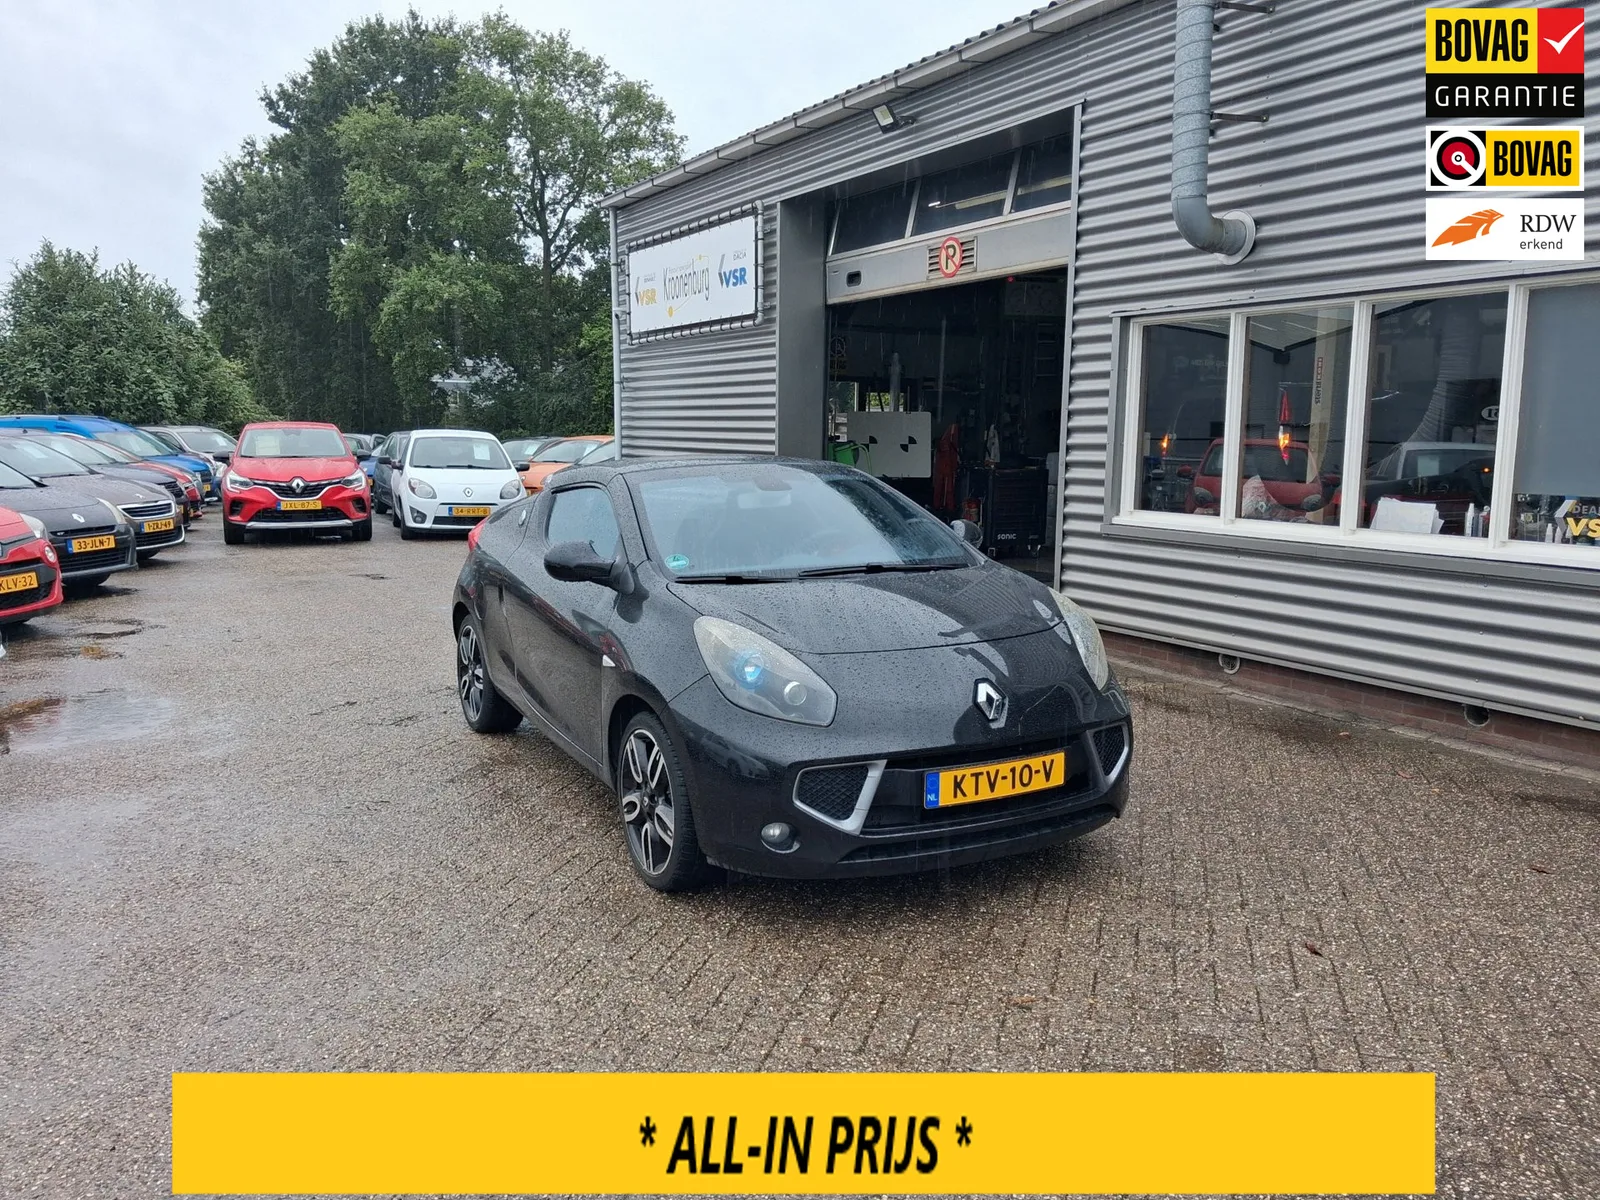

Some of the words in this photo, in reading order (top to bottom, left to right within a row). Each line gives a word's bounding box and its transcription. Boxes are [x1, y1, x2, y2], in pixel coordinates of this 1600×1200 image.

[662, 258, 710, 301] Kroonenburg
[723, 266, 748, 288] VSR
[639, 288, 657, 306] VSR
[1571, 504, 1600, 516] DEA
[76, 536, 112, 550] 33-JLN-7
[927, 793, 938, 801] NL
[953, 758, 1055, 799] KTV-10-V
